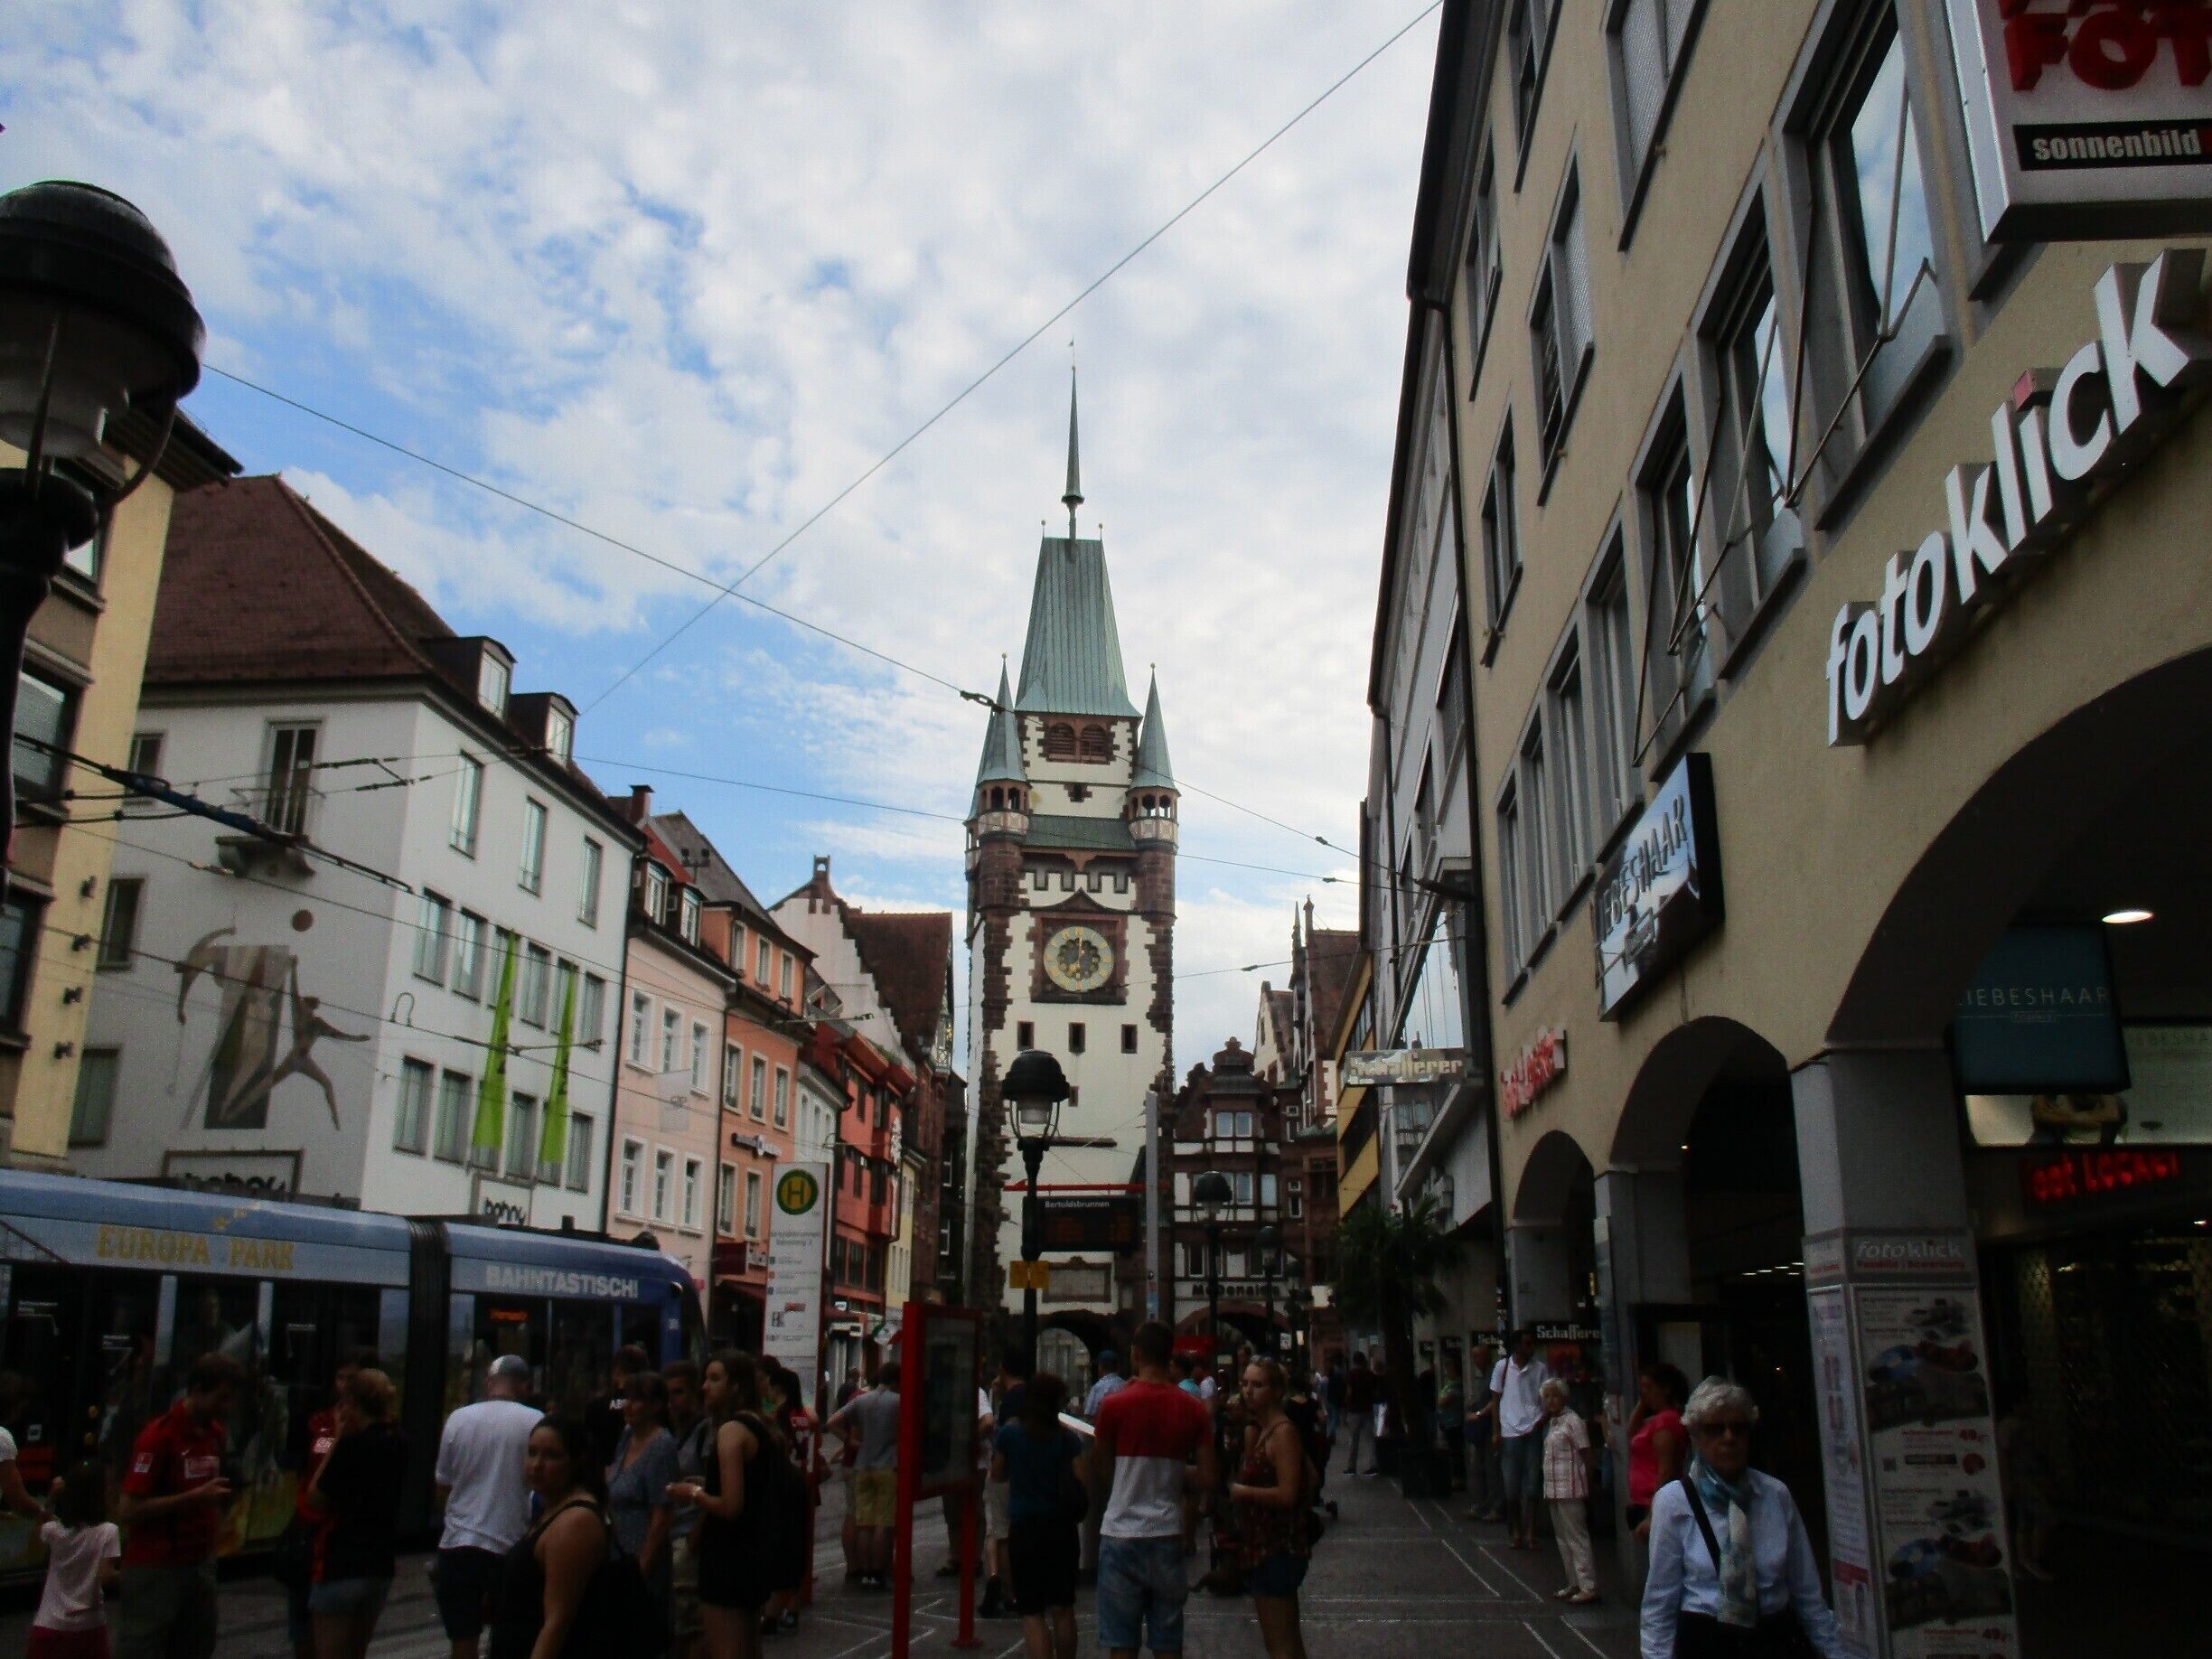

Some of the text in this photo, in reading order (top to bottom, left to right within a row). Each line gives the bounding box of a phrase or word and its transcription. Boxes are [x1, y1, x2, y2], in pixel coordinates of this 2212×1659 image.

[2032, 127, 2202, 161] sonnenbild
[1825, 248, 2190, 748] fotoklick
[1954, 986, 2112, 1006] IEBESHAAR
[1044, 1199, 1111, 1209] Bertoldsbrunnen
[96, 1223, 296, 1271] EUROPA PARK
